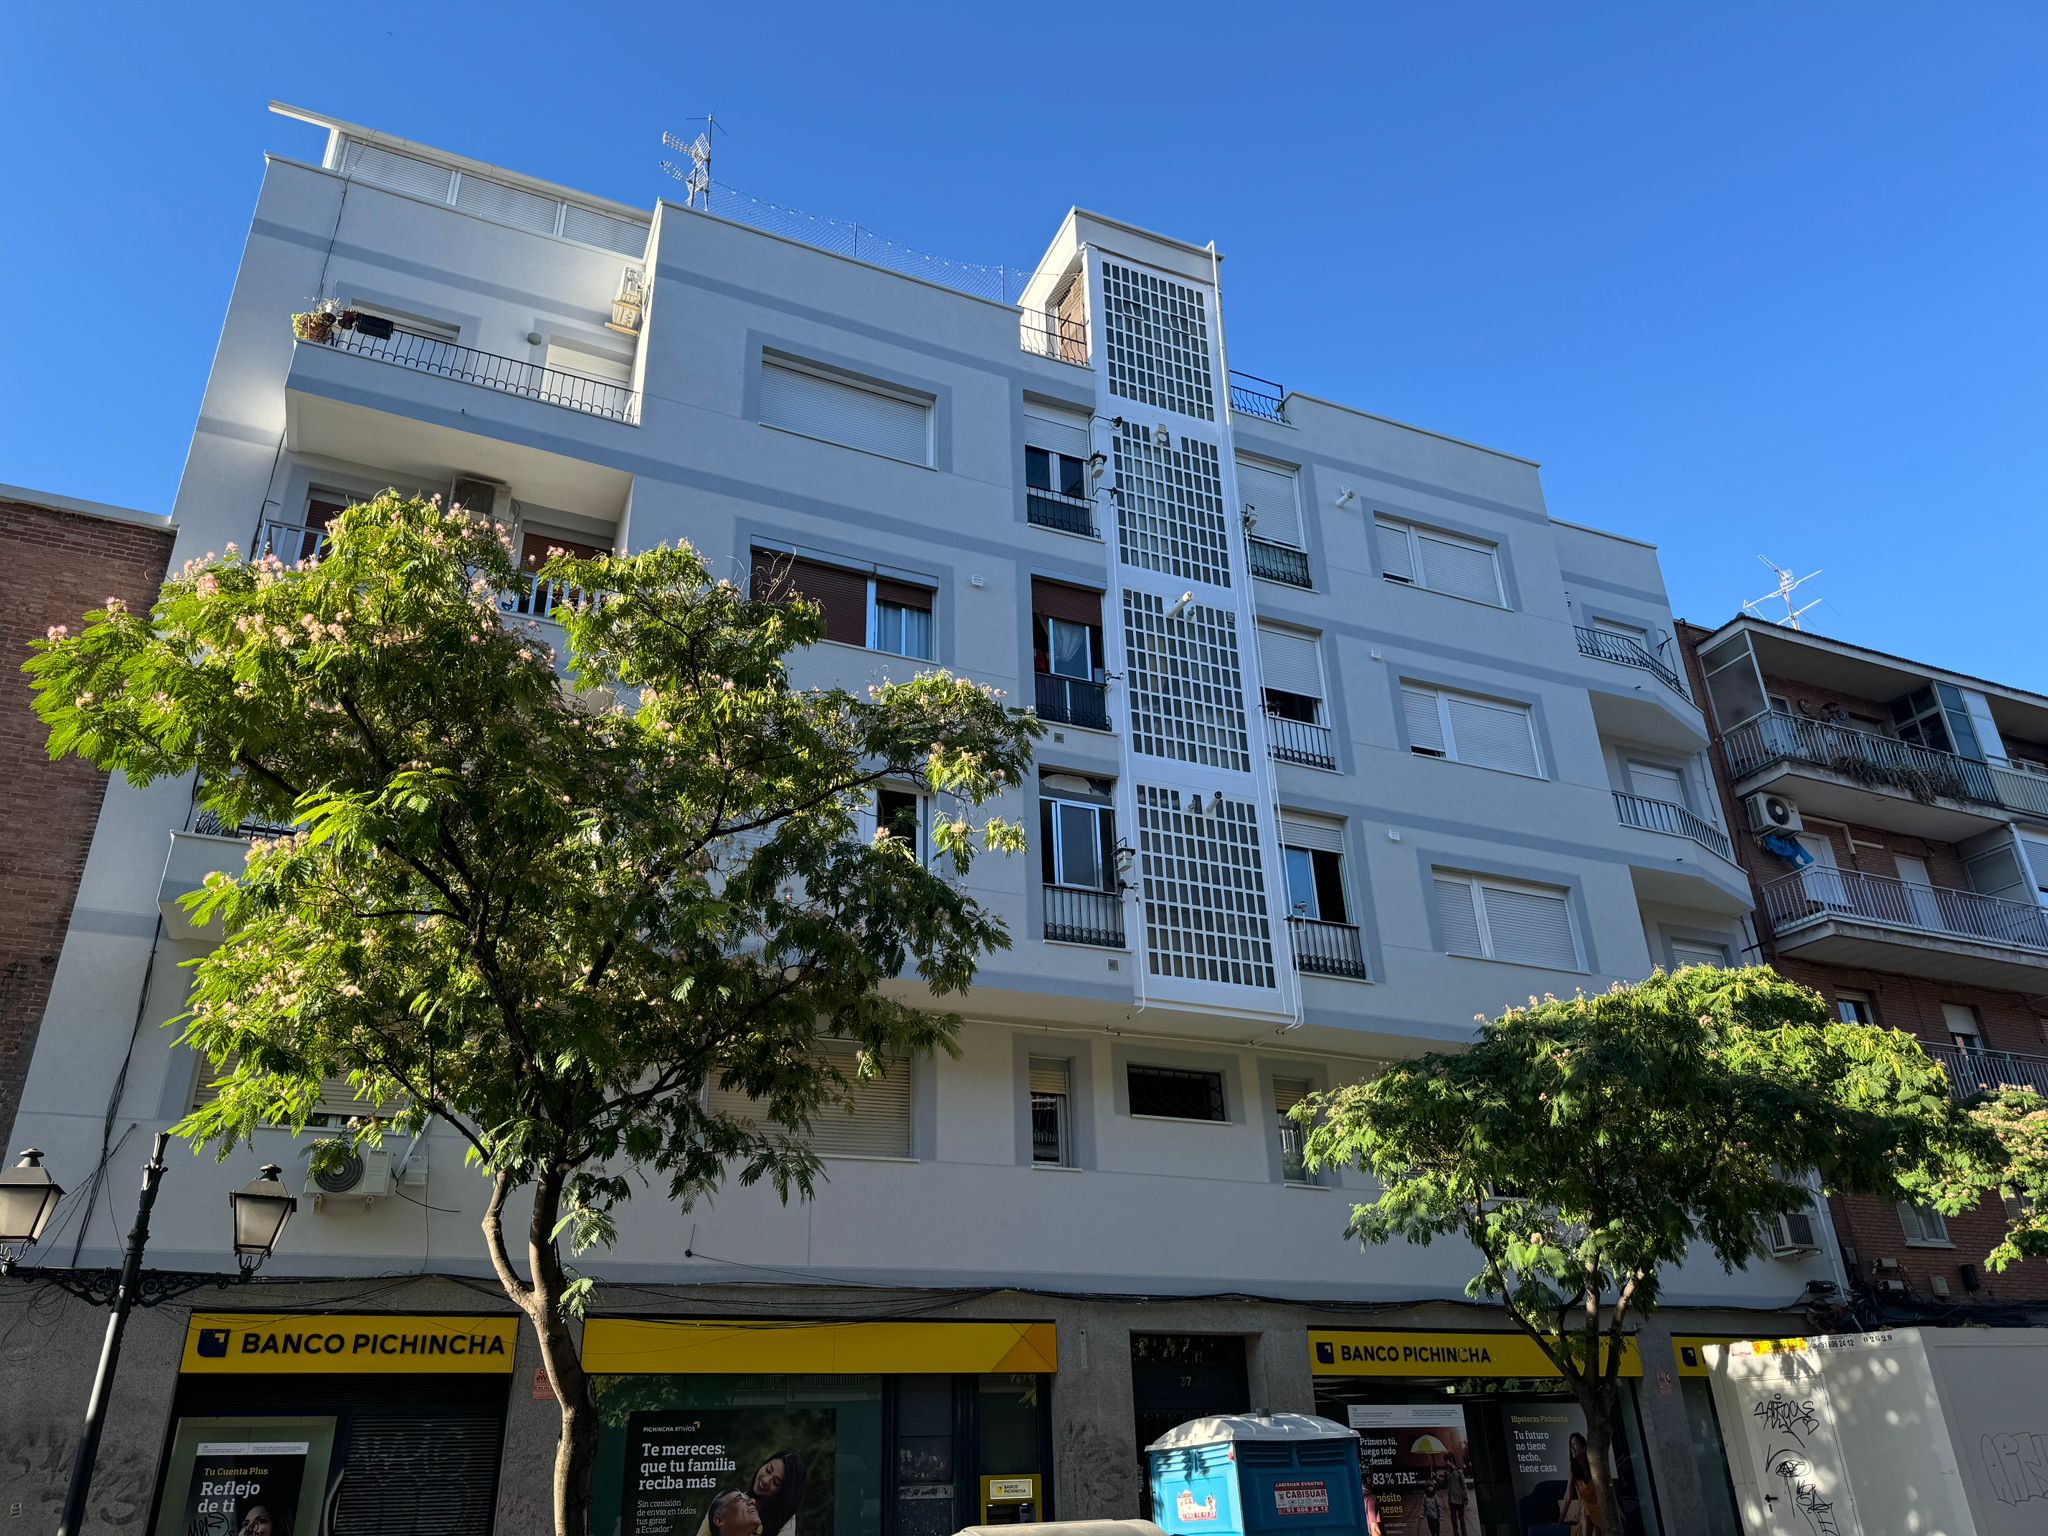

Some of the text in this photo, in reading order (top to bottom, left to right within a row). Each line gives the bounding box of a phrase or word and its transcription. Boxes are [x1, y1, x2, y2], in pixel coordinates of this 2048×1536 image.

[241, 1332, 506, 1355] BANCO PICHINCHA
[1340, 1345, 1492, 1363] BANCO PICHINCHA
[675, 1424, 695, 1432] envíos
[1513, 1430, 1549, 1440] Tu futuro
[1360, 1437, 1387, 1446] Primero
[1515, 1441, 1546, 1451] no tiene
[642, 1443, 726, 1456] Te mereces:
[1360, 1447, 1396, 1457] luego todo
[1370, 1457, 1392, 1466] demás
[1518, 1452, 1541, 1462] techo,
[204, 1467, 269, 1476] Tu Cuenta Plus
[640, 1458, 736, 1477] que tu familia
[1520, 1463, 1558, 1472] tiene casa
[639, 1474, 717, 1490] reciba más
[200, 1481, 260, 1499] Reflejo
[1285, 1489, 1327, 1499] CABISUAR
[197, 1499, 236, 1513] de ti
[637, 1499, 681, 1508] Sin comisión
[677, 1507, 697, 1515] todos
[636, 1516, 667, 1526] tus giros
